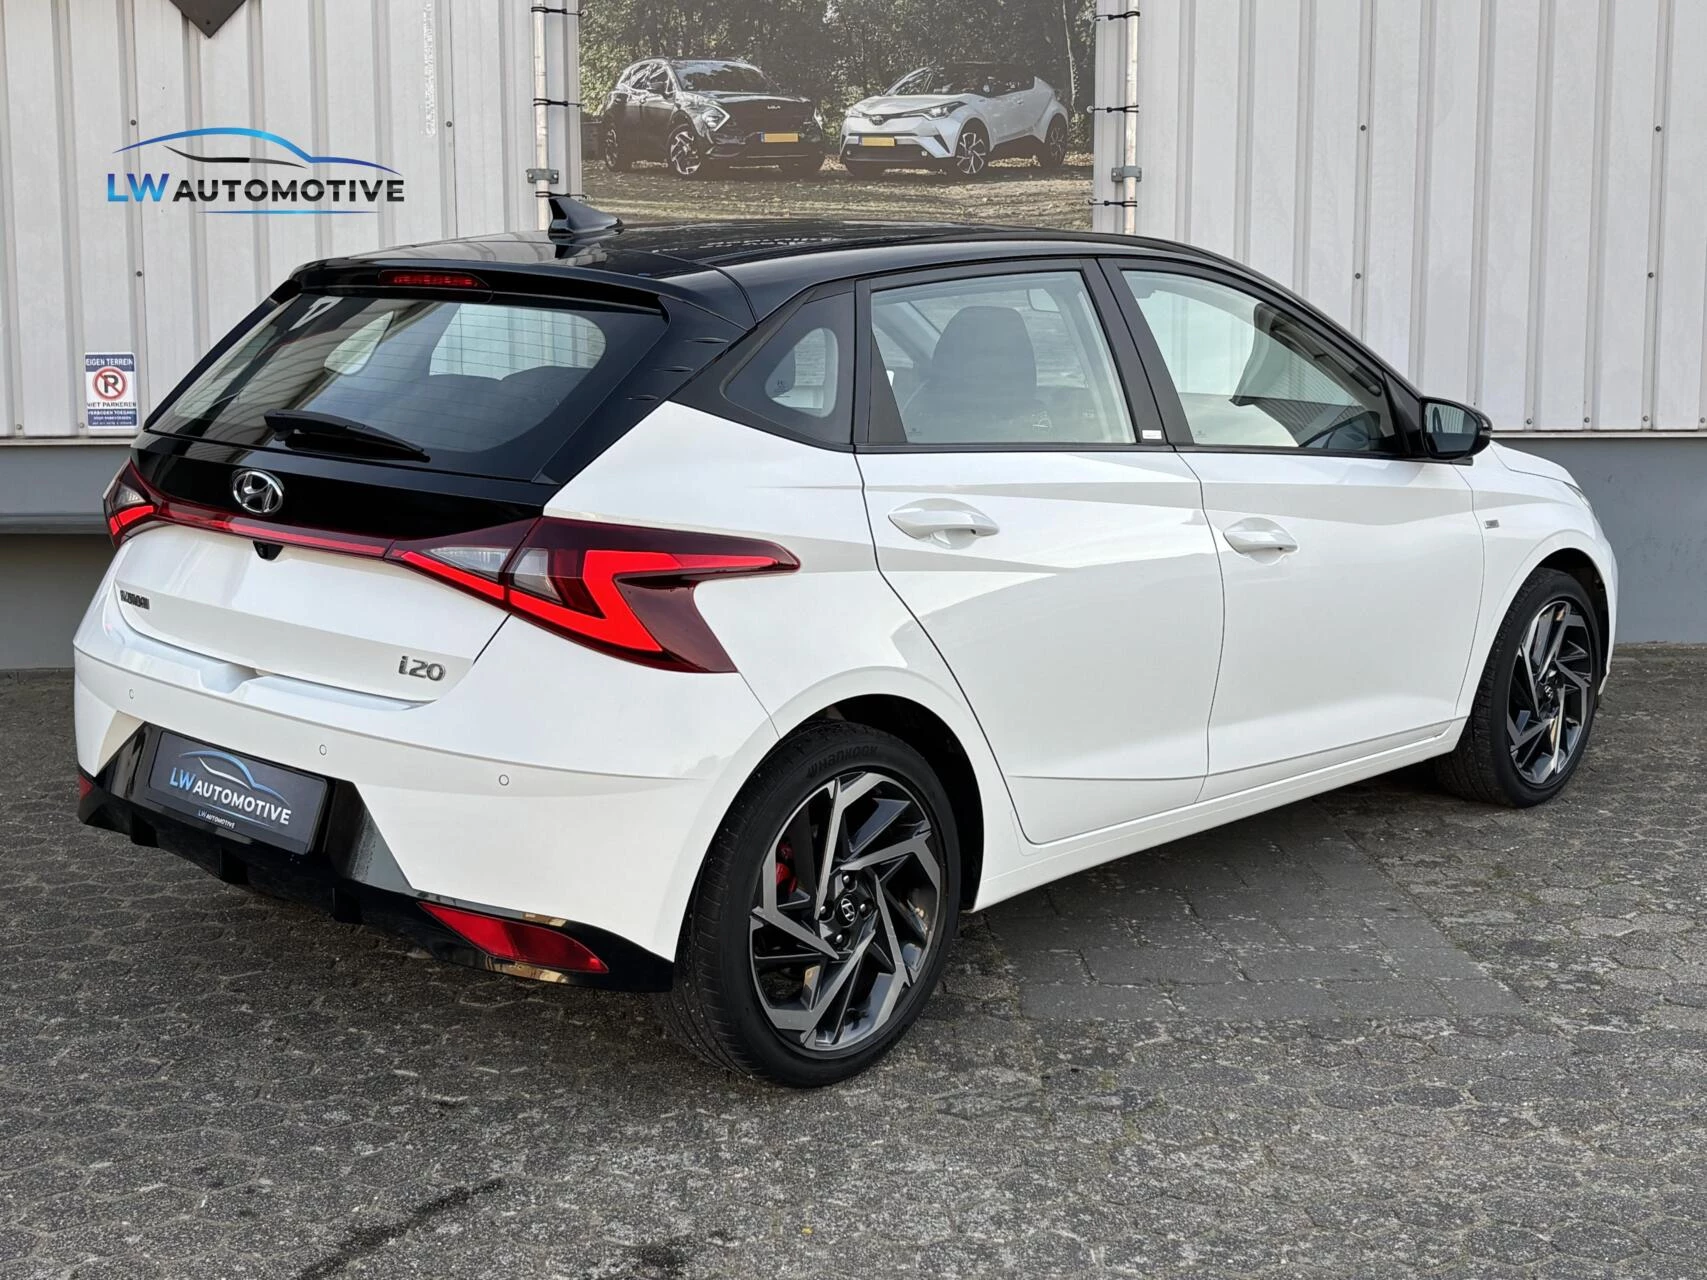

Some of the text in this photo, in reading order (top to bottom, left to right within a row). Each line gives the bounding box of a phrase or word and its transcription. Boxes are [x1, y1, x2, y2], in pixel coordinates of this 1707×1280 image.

[86, 358, 133, 366] EIGEN TERREIN
[169, 767, 292, 825] LW AUTOMOTIVE
[205, 813, 236, 829] AUTOMOTIVE
